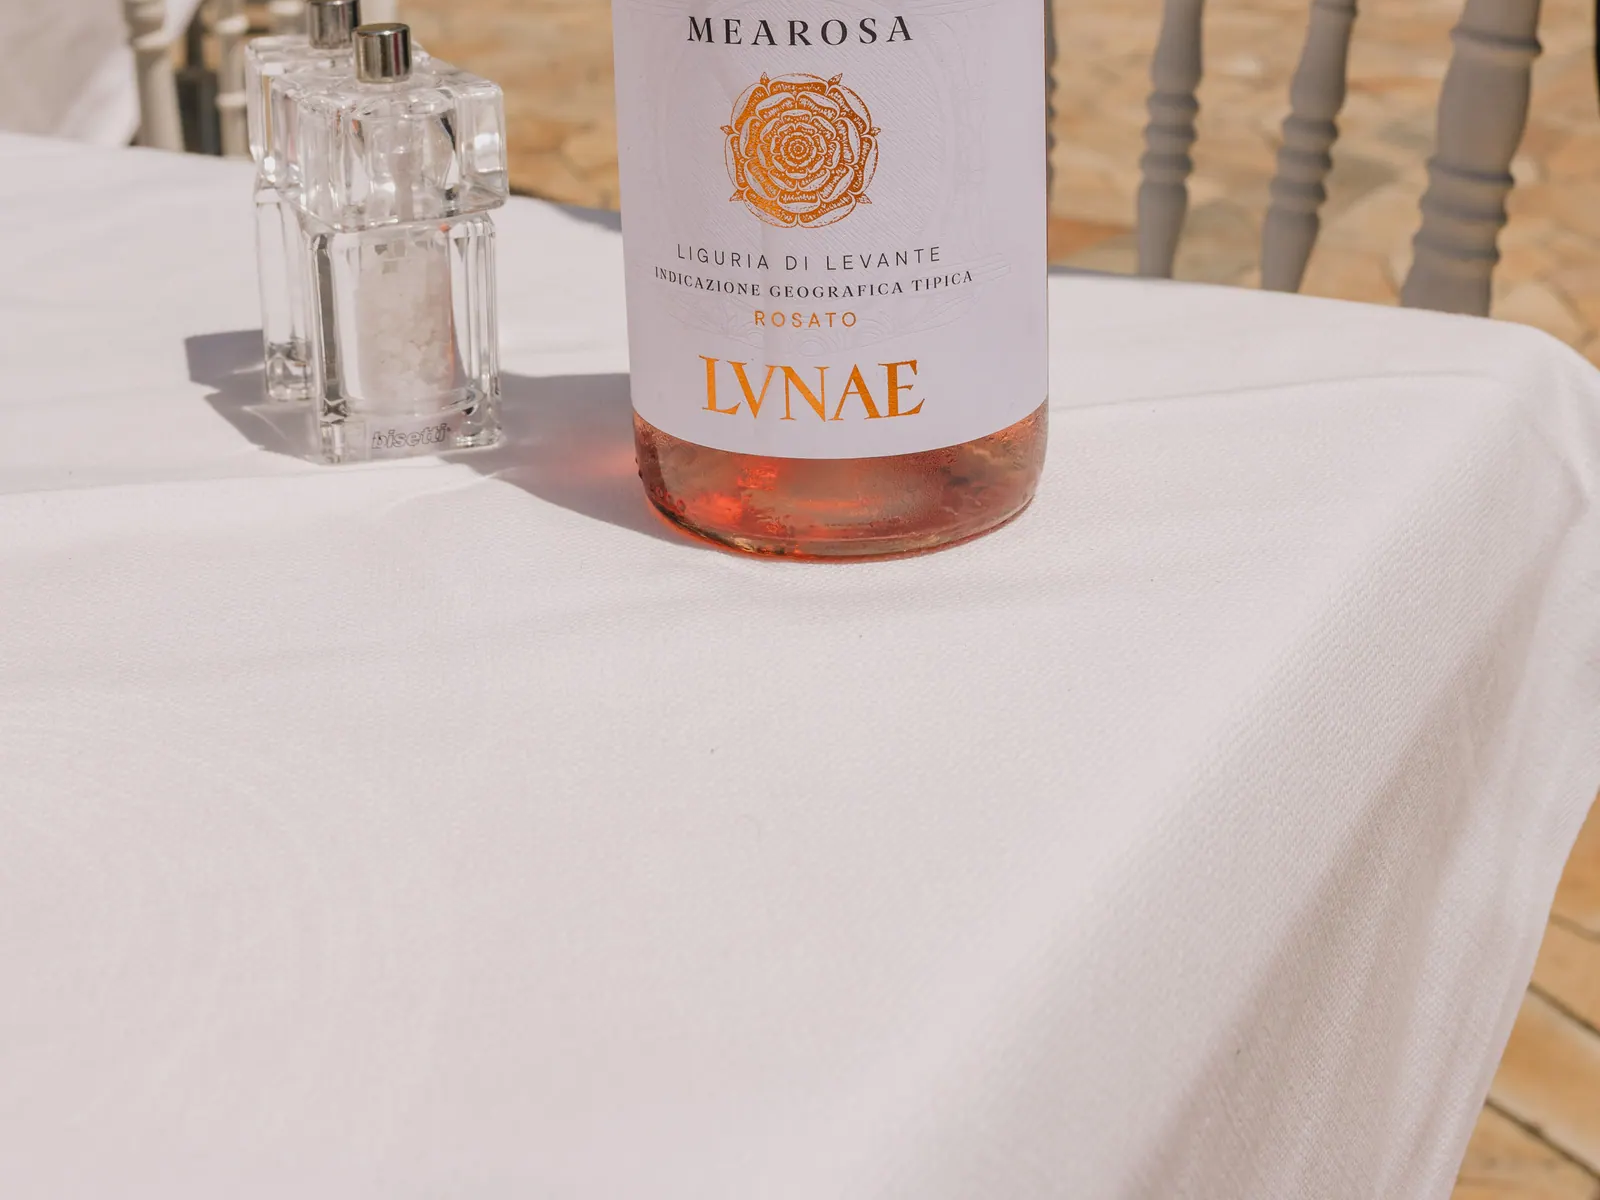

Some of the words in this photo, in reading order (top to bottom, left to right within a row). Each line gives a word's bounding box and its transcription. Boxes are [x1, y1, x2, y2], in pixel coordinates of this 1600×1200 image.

[687, 15, 913, 47] MEAROSA
[676, 243, 770, 271] LIGURIA
[785, 255, 808, 271] DI
[826, 245, 941, 271] LEVANTE
[654, 266, 761, 297] INDICAZIONE
[769, 283, 904, 299] GEOGRAFICA
[911, 270, 973, 295] TIPICA
[754, 310, 858, 329] ROSATO
[698, 354, 925, 423] LVNAE
[371, 423, 447, 450] bisetti
